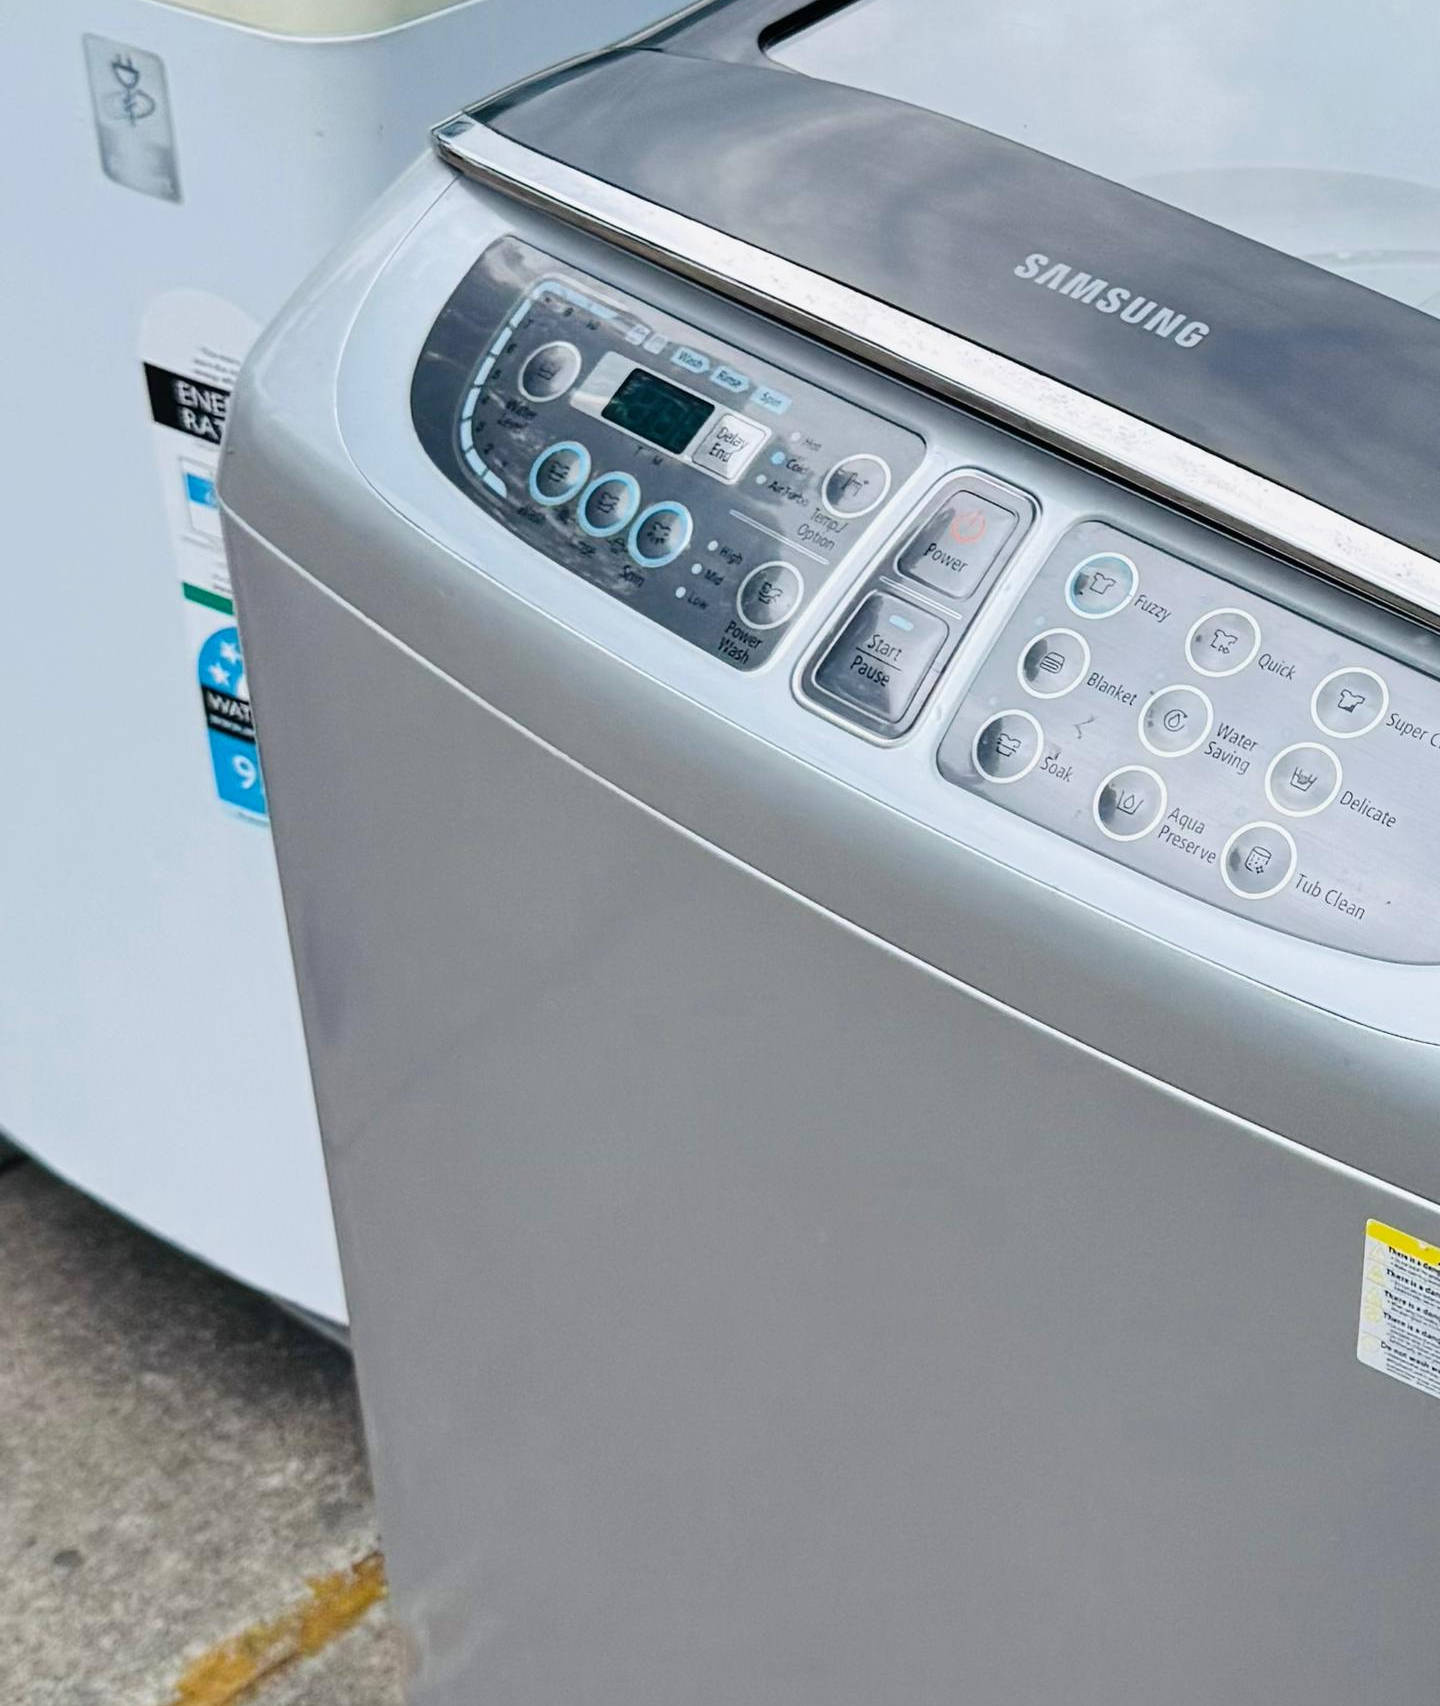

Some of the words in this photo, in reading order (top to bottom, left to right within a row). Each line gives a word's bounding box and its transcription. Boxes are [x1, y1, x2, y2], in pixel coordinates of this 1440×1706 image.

[1014, 253, 1210, 348] SAMSUNG
[677, 349, 703, 368] Wash
[715, 425, 749, 452] Delay
[708, 443, 733, 464] End
[797, 523, 836, 551] Option
[719, 546, 744, 566] High
[923, 542, 969, 574] Power
[704, 568, 724, 587] Mid
[687, 590, 710, 610] Low
[1134, 594, 1172, 623] Fuzzy
[724, 619, 763, 649] Power
[867, 633, 903, 662] Start
[717, 636, 750, 664] Wash
[849, 655, 891, 688] Pause
[1258, 653, 1297, 681] Quick
[1086, 672, 1138, 706] Blanket
[1216, 722, 1260, 752] Water
[1386, 713, 1429, 740] Super
[1040, 755, 1075, 783] Soak
[1204, 741, 1251, 775] Saving
[1167, 807, 1206, 835] Aqua
[1340, 790, 1397, 828] Delicate
[1157, 824, 1217, 864] Preserve
[1295, 873, 1322, 898] Tub
[1324, 889, 1366, 920] Clean
[1388, 1246, 1407, 1260] There
[1386, 1268, 1408, 1284] There
[1384, 1289, 1406, 1304] There
